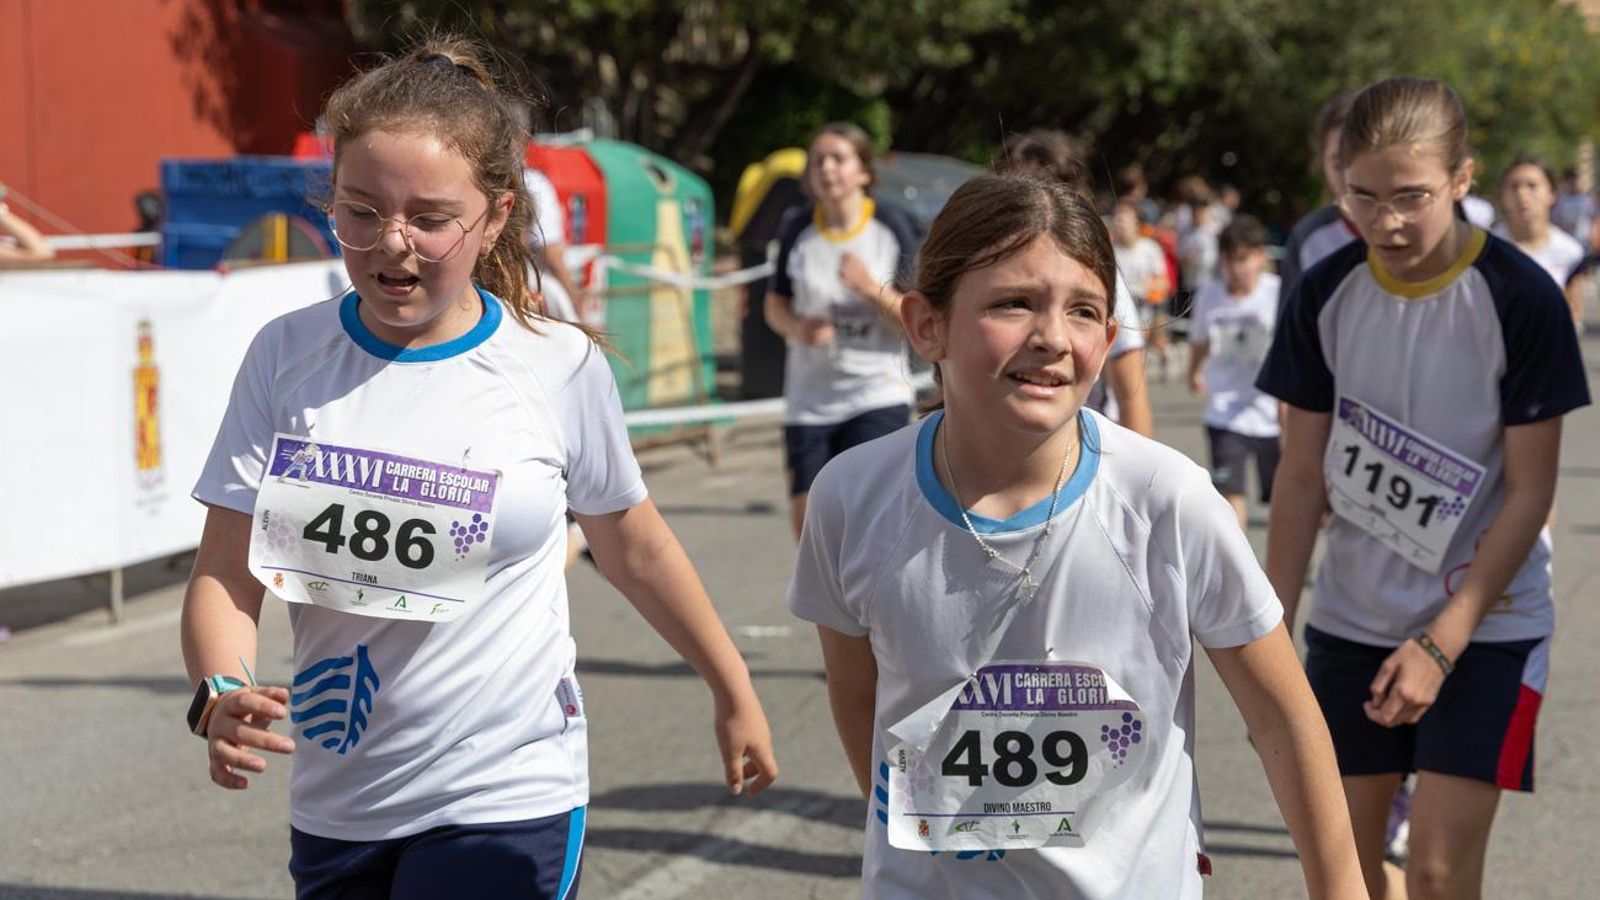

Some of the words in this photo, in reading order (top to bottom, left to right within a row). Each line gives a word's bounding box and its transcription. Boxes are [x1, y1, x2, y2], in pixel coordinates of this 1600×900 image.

[308, 450, 384, 487] XXXVI
[386, 461, 437, 482] CARRERA
[440, 471, 490, 493] ESCOLAR
[393, 477, 409, 493] LA
[420, 482, 472, 505] GLORIA
[1344, 444, 1440, 528] 1191
[303, 503, 437, 570] 486
[351, 571, 378, 585] TRIANA
[958, 672, 1012, 707] XVI
[1015, 672, 1072, 688] CARRERA
[1075, 672, 1107, 688] ESCO
[1026, 688, 1045, 705] LA
[941, 730, 1089, 787] 489
[984, 802, 1012, 813] DIVINO
[1012, 801, 1052, 813] MAESTRO
